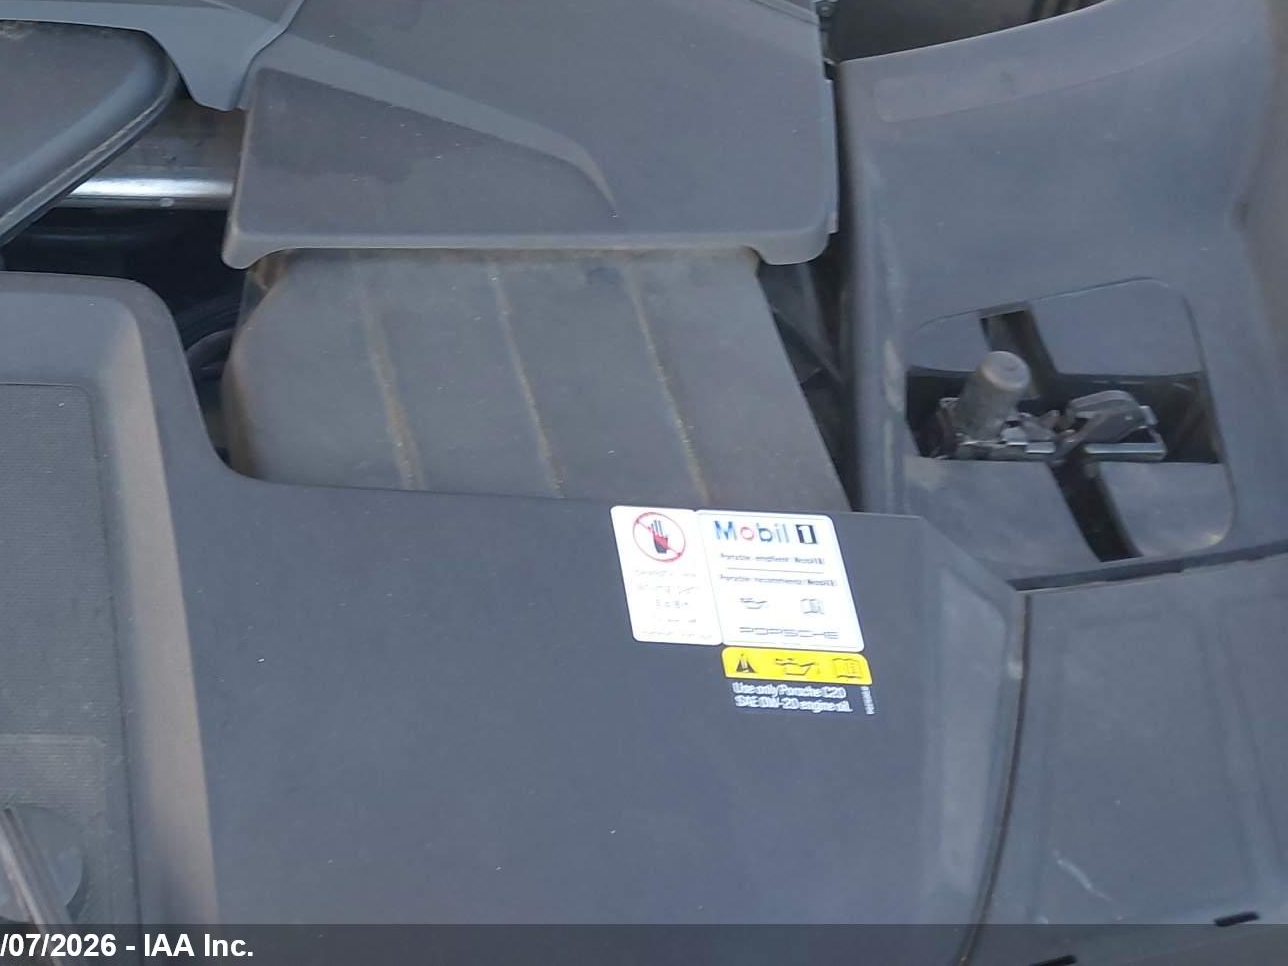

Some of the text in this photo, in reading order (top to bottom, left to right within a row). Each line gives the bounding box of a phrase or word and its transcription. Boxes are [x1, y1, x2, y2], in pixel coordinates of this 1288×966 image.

[714, 520, 818, 545] Mobil 1
[778, 684, 822, 698] Porsche
